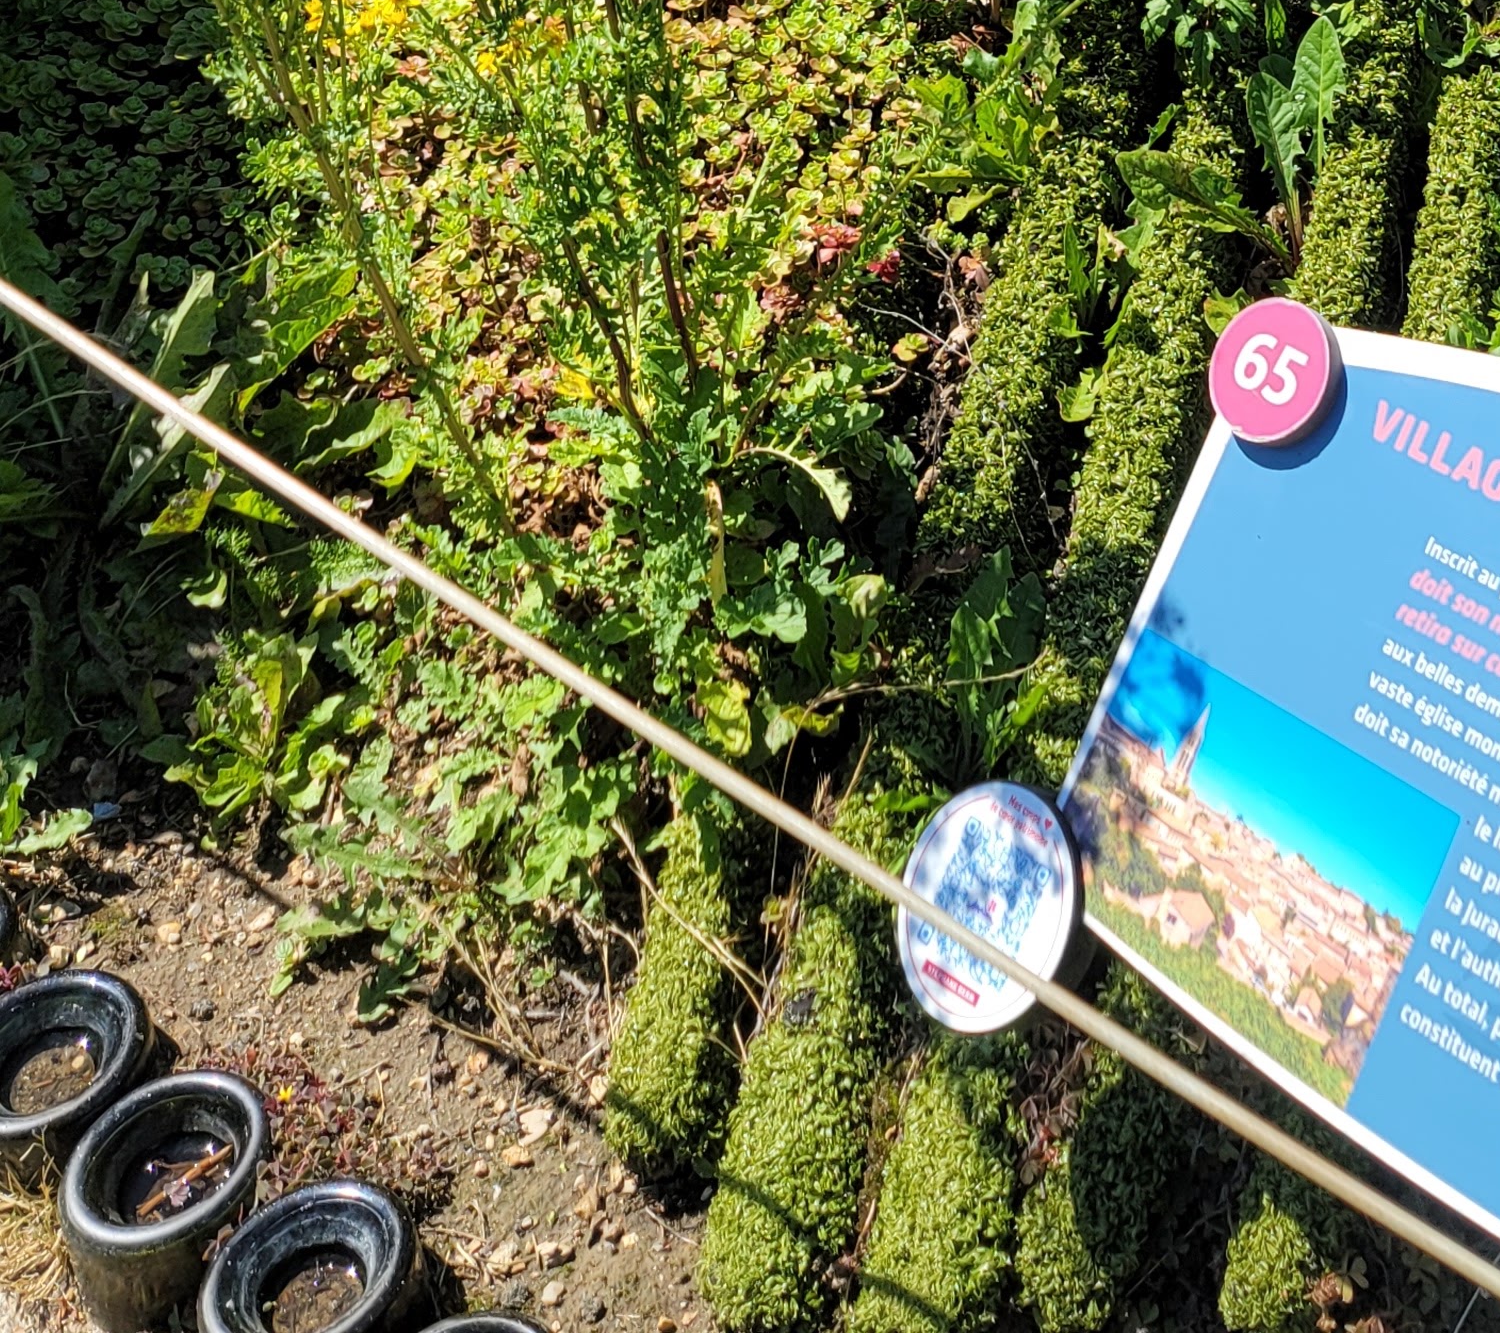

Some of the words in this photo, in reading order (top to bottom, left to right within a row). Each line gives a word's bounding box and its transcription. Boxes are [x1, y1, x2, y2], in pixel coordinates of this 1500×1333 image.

[1233, 332, 1310, 406] 65
[1424, 536, 1478, 578] Inscrit
[1477, 568, 1500, 590] au
[1409, 568, 1453, 605] doit
[1450, 592, 1490, 625] son
[1395, 603, 1453, 645] retira
[1450, 633, 1487, 663] sur
[1382, 638, 1414, 667] aux
[1413, 651, 1464, 695] belles
[1369, 671, 1413, 708] vaste
[1413, 695, 1463, 737] église
[1353, 703, 1389, 736] doit
[1388, 725, 1409, 749] sa
[1409, 738, 1488, 795] notoriété
[1473, 814, 1492, 842] le
[1459, 856, 1483, 882] au
[1444, 886, 1463, 915] la
[1429, 929, 1451, 954] et
[1414, 963, 1442, 995] Au
[1443, 980, 1487, 1029] total,
[1399, 1003, 1500, 1082] constituent
